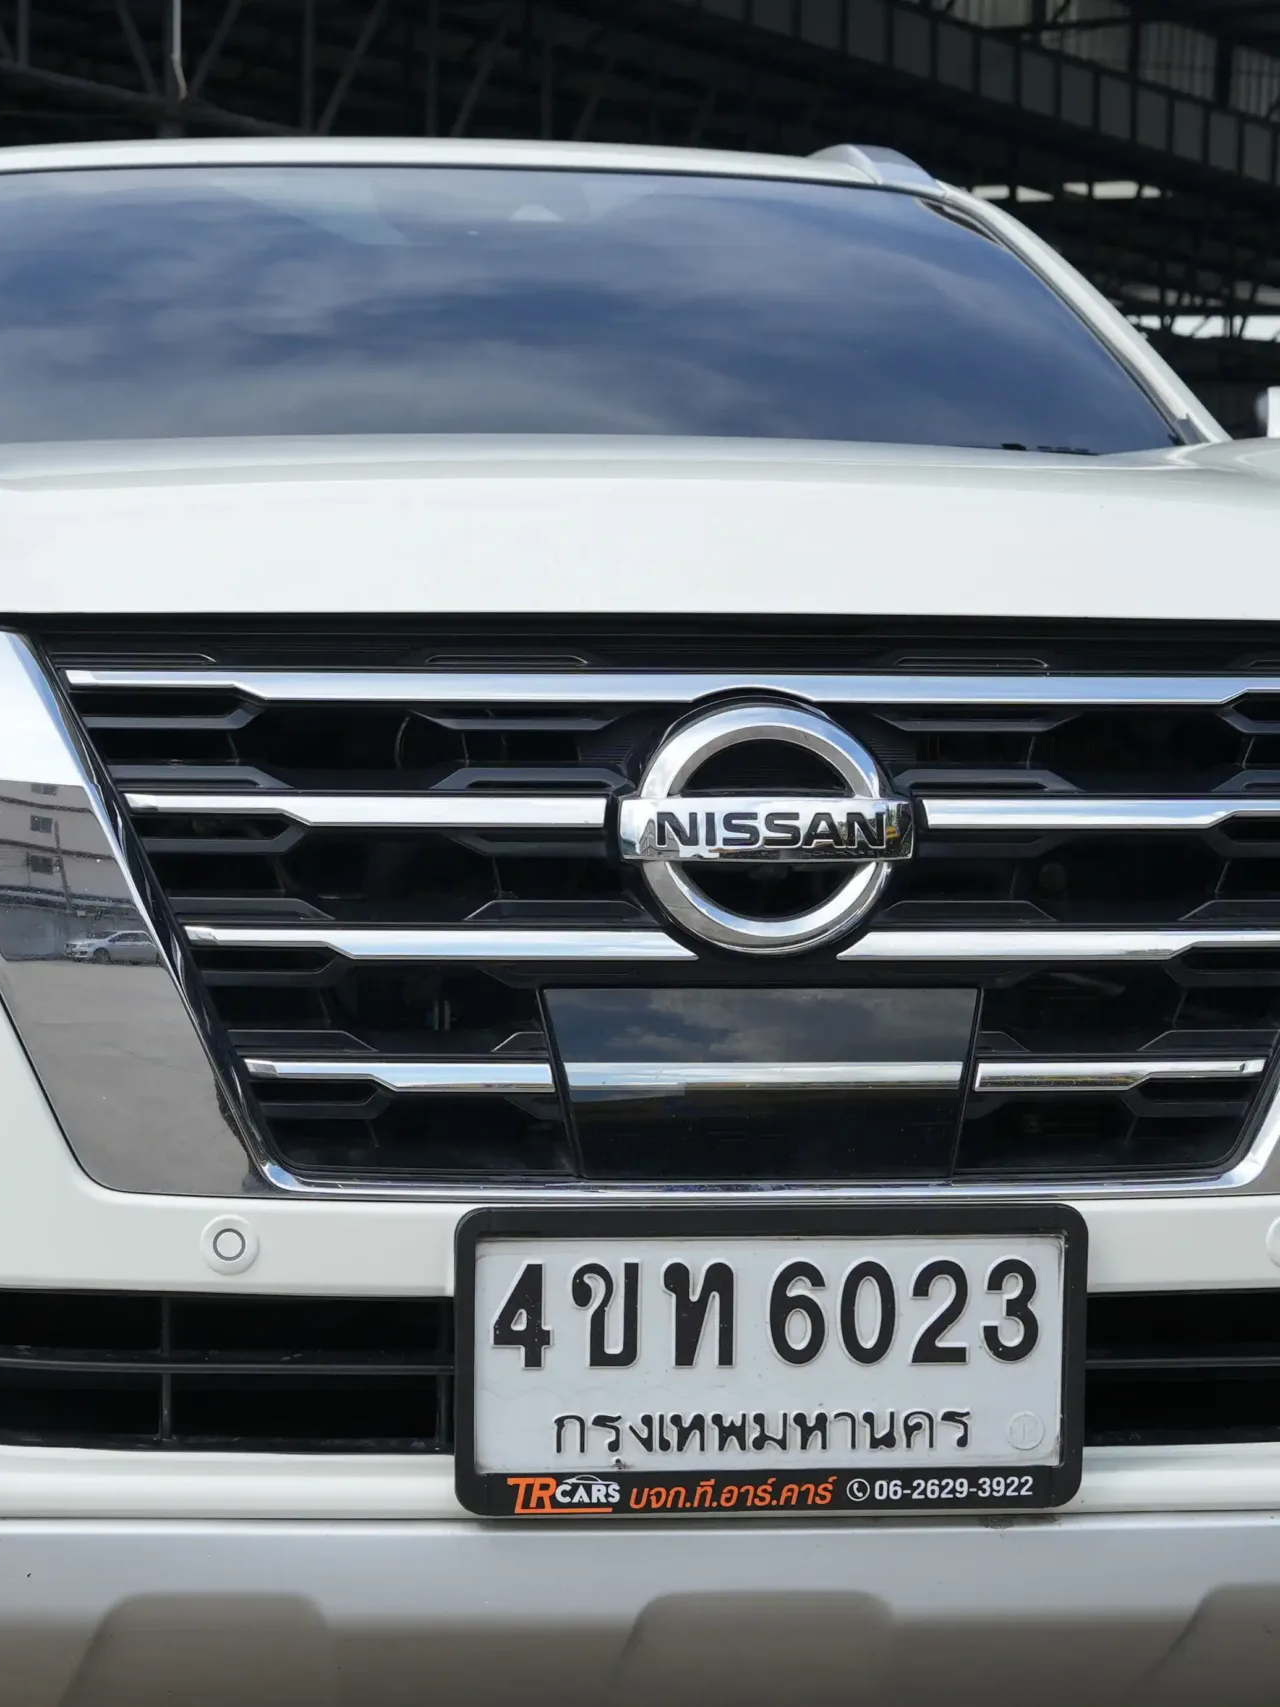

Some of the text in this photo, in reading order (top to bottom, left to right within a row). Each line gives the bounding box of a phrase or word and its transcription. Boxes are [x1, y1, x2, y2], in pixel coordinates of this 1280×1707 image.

[656, 811, 887, 849] NISSAN
[768, 1257, 1040, 1366] 6023
[554, 1410, 971, 1469] กรุงเทพมหานคร
[629, 1476, 838, 1509] บจก.ที.อาร์.คาร์
[874, 1476, 1034, 1501] 06-2629-3922
